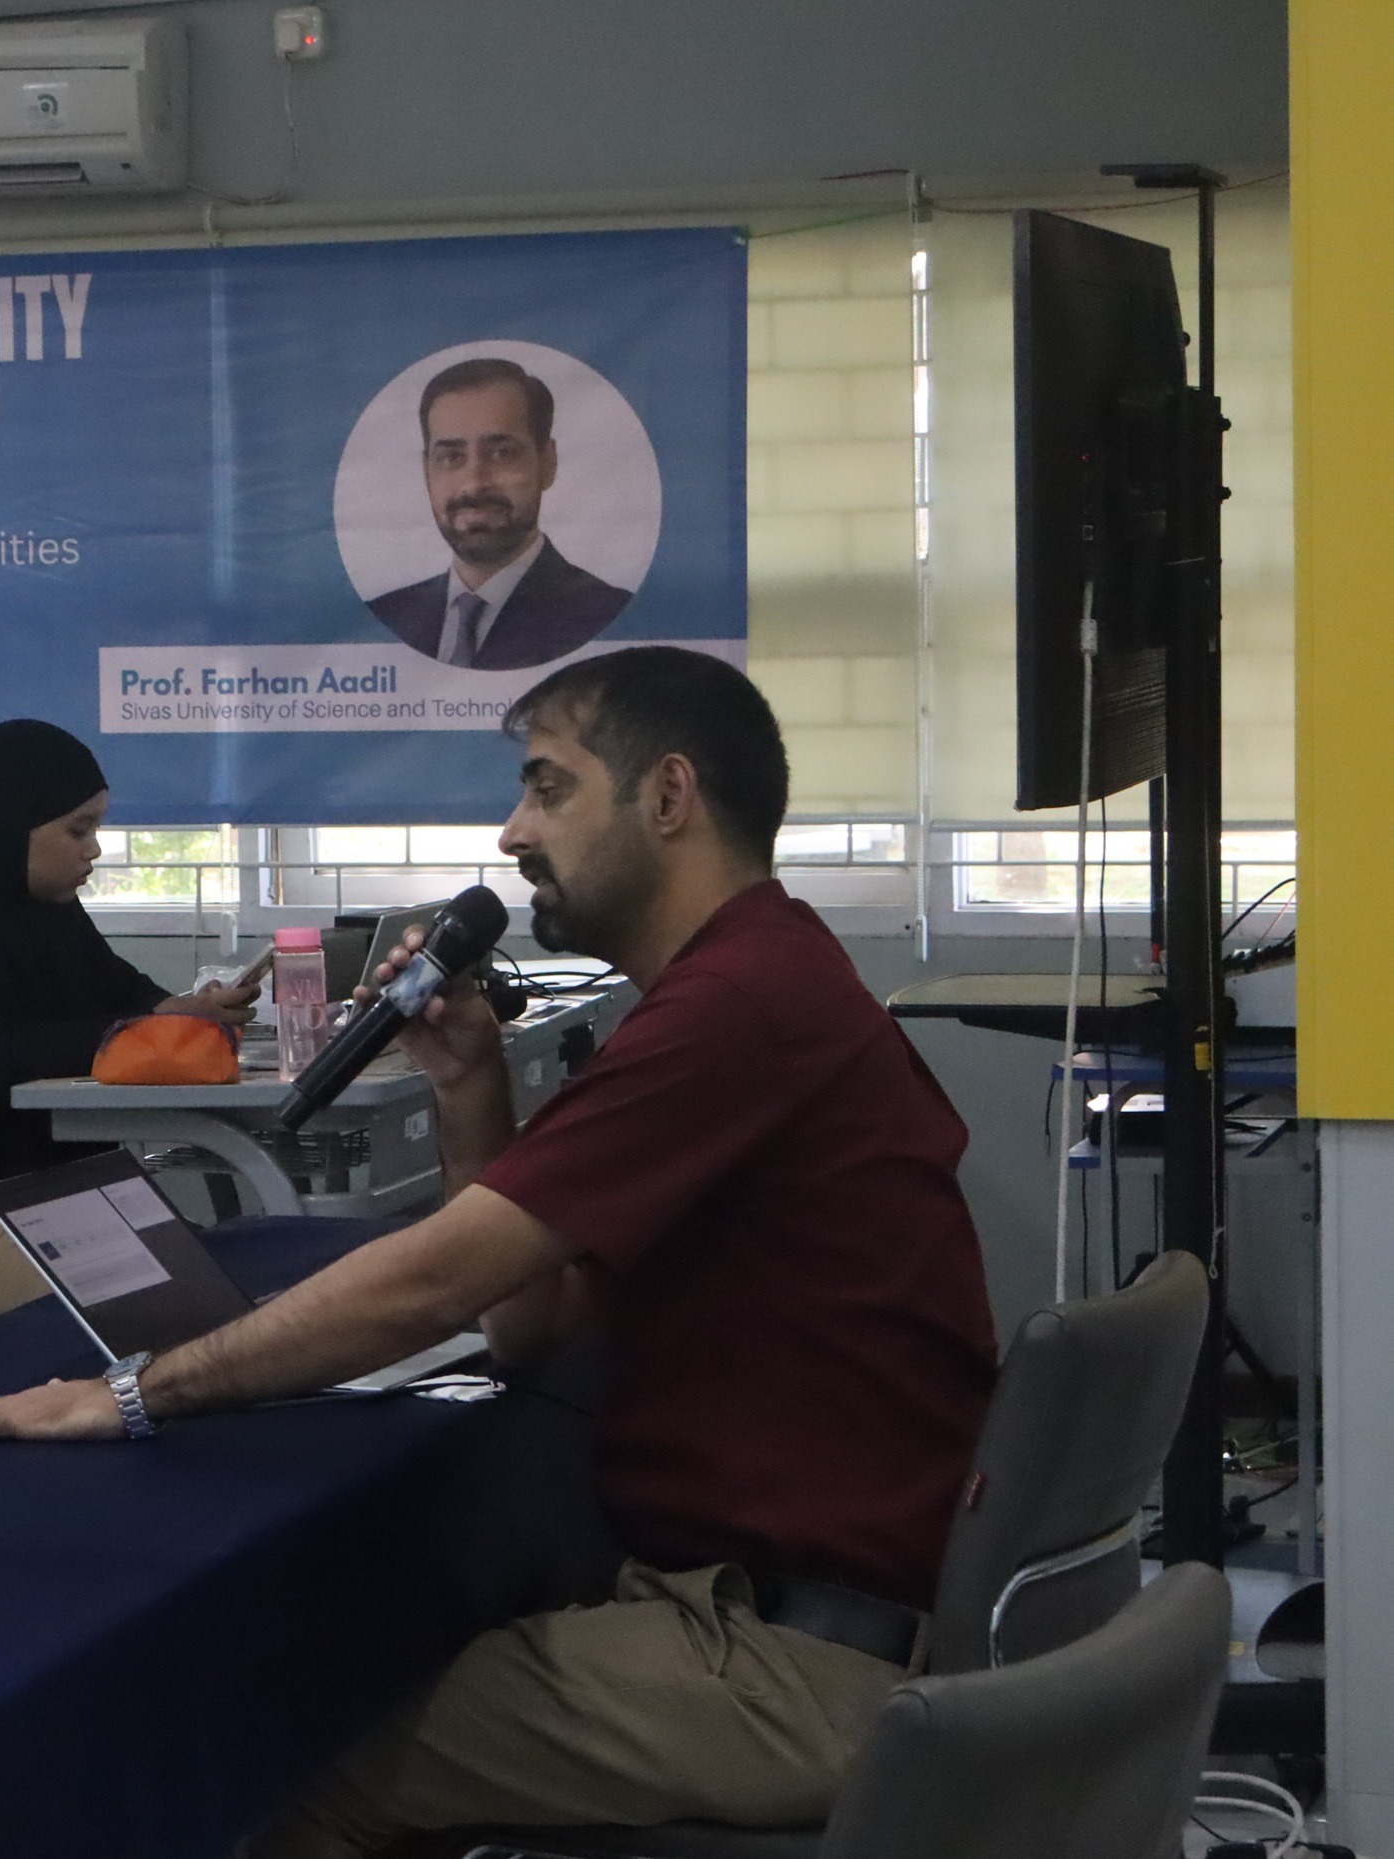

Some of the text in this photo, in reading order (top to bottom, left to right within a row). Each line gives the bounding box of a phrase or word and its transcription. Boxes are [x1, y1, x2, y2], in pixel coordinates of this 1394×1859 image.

[121, 665, 398, 696] Prof. Farhan Aadil
[121, 698, 512, 725] Sivas University of Science and Techno
